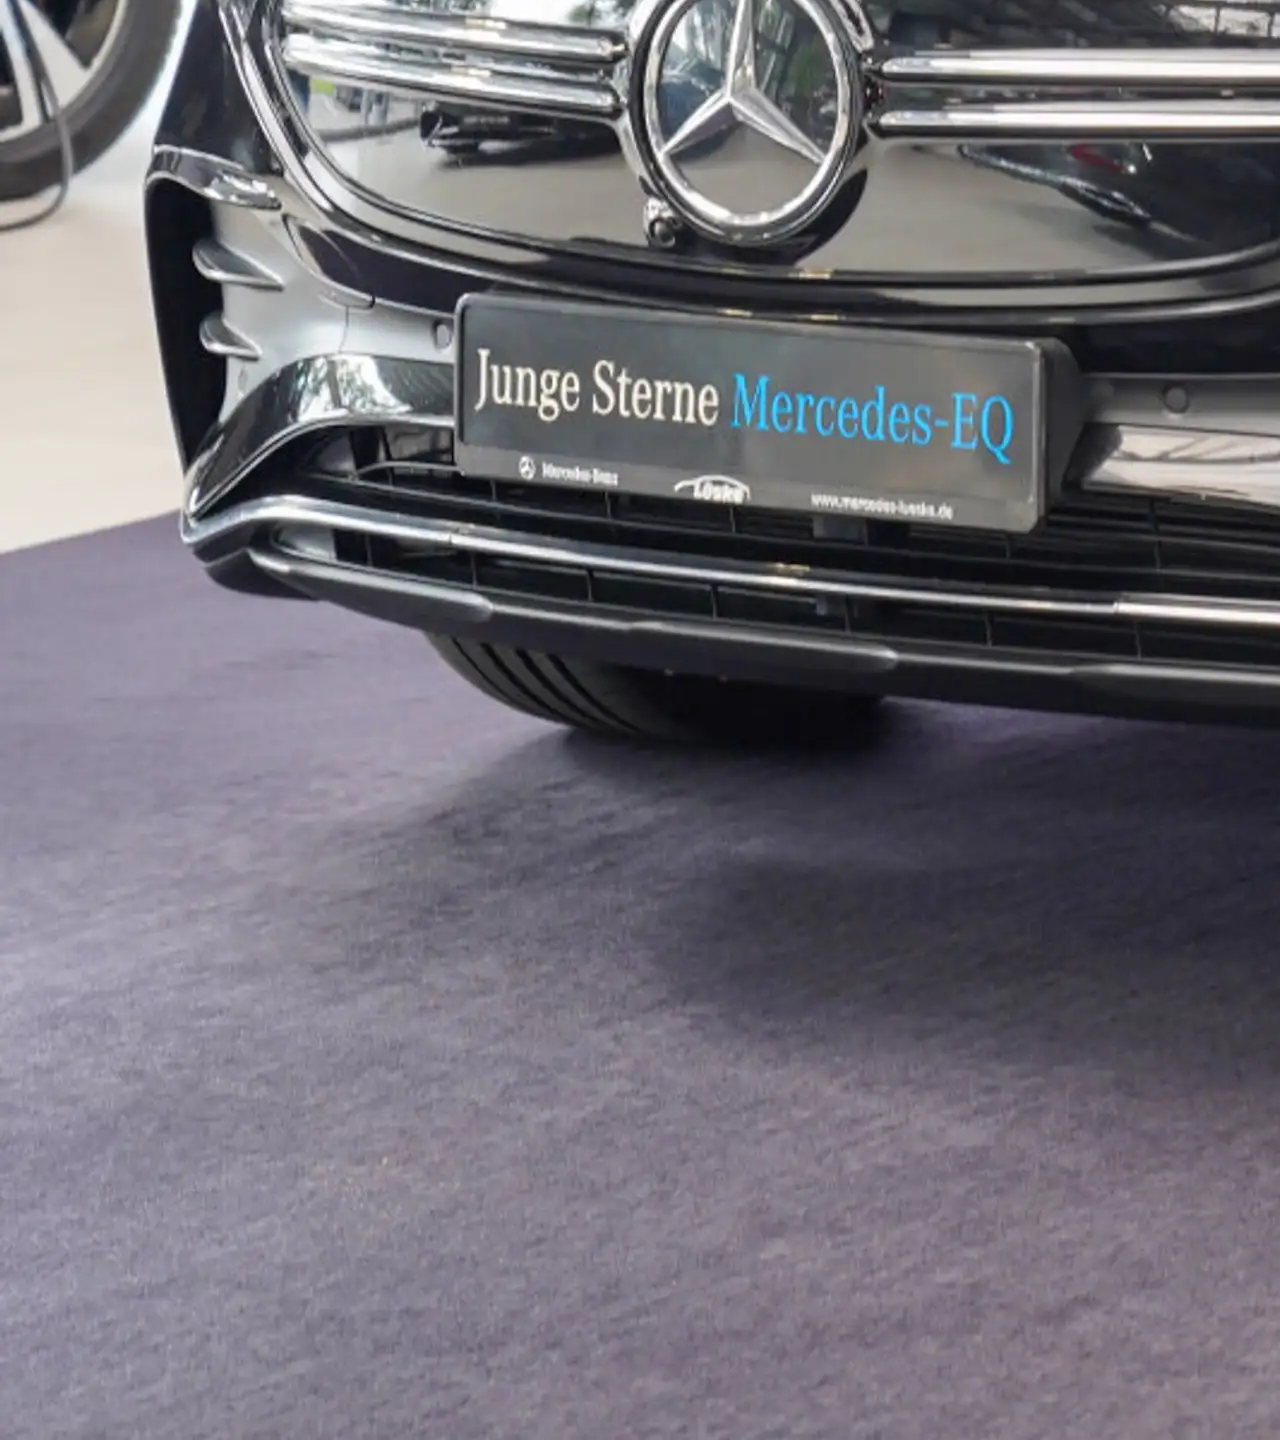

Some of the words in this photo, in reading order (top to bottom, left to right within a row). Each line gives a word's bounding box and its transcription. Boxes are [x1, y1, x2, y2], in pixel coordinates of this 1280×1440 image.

[475, 348, 580, 421] Junge
[592, 359, 720, 426] Sterne
[731, 372, 1014, 464] Mercedes-EQ
